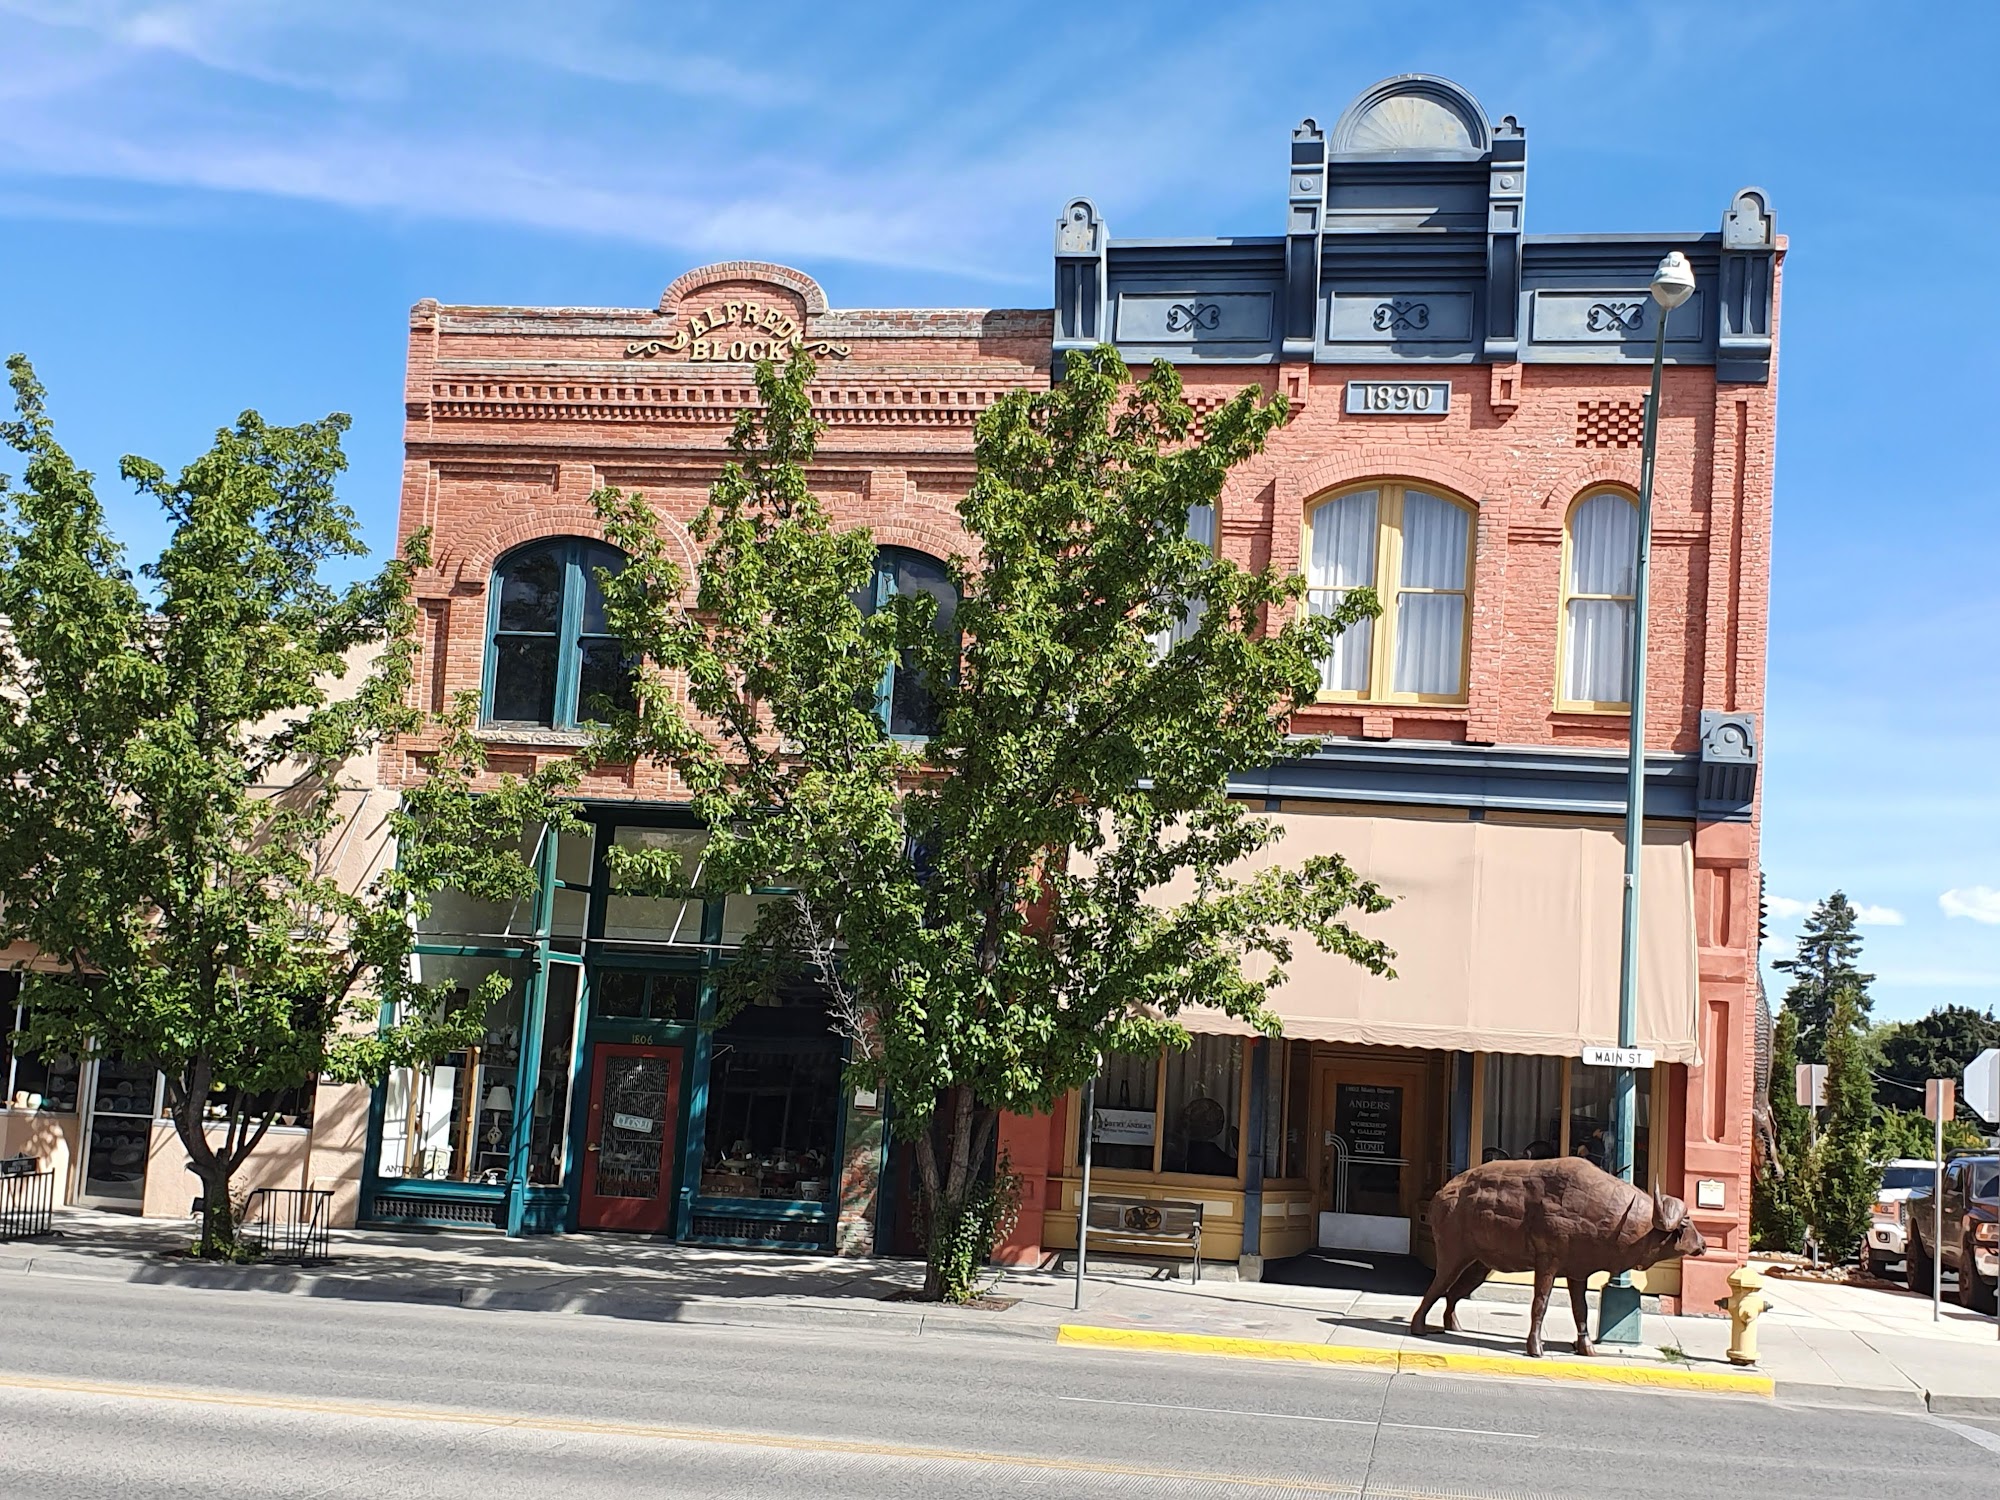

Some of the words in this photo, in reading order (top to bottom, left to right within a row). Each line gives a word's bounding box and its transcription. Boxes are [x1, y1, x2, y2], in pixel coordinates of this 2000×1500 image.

[690, 300, 796, 338] ALFRED
[690, 339, 788, 361] BLOCK
[1365, 385, 1433, 410] 1890
[632, 1034, 653, 1045] 1806
[1595, 1051, 1623, 1063] MAIN
[1349, 1100, 1391, 1110] ANDERS
[616, 1115, 650, 1128] CLOSED
[1357, 1128, 1387, 1136] GALLERY
[1355, 1142, 1384, 1151] CLOSED
